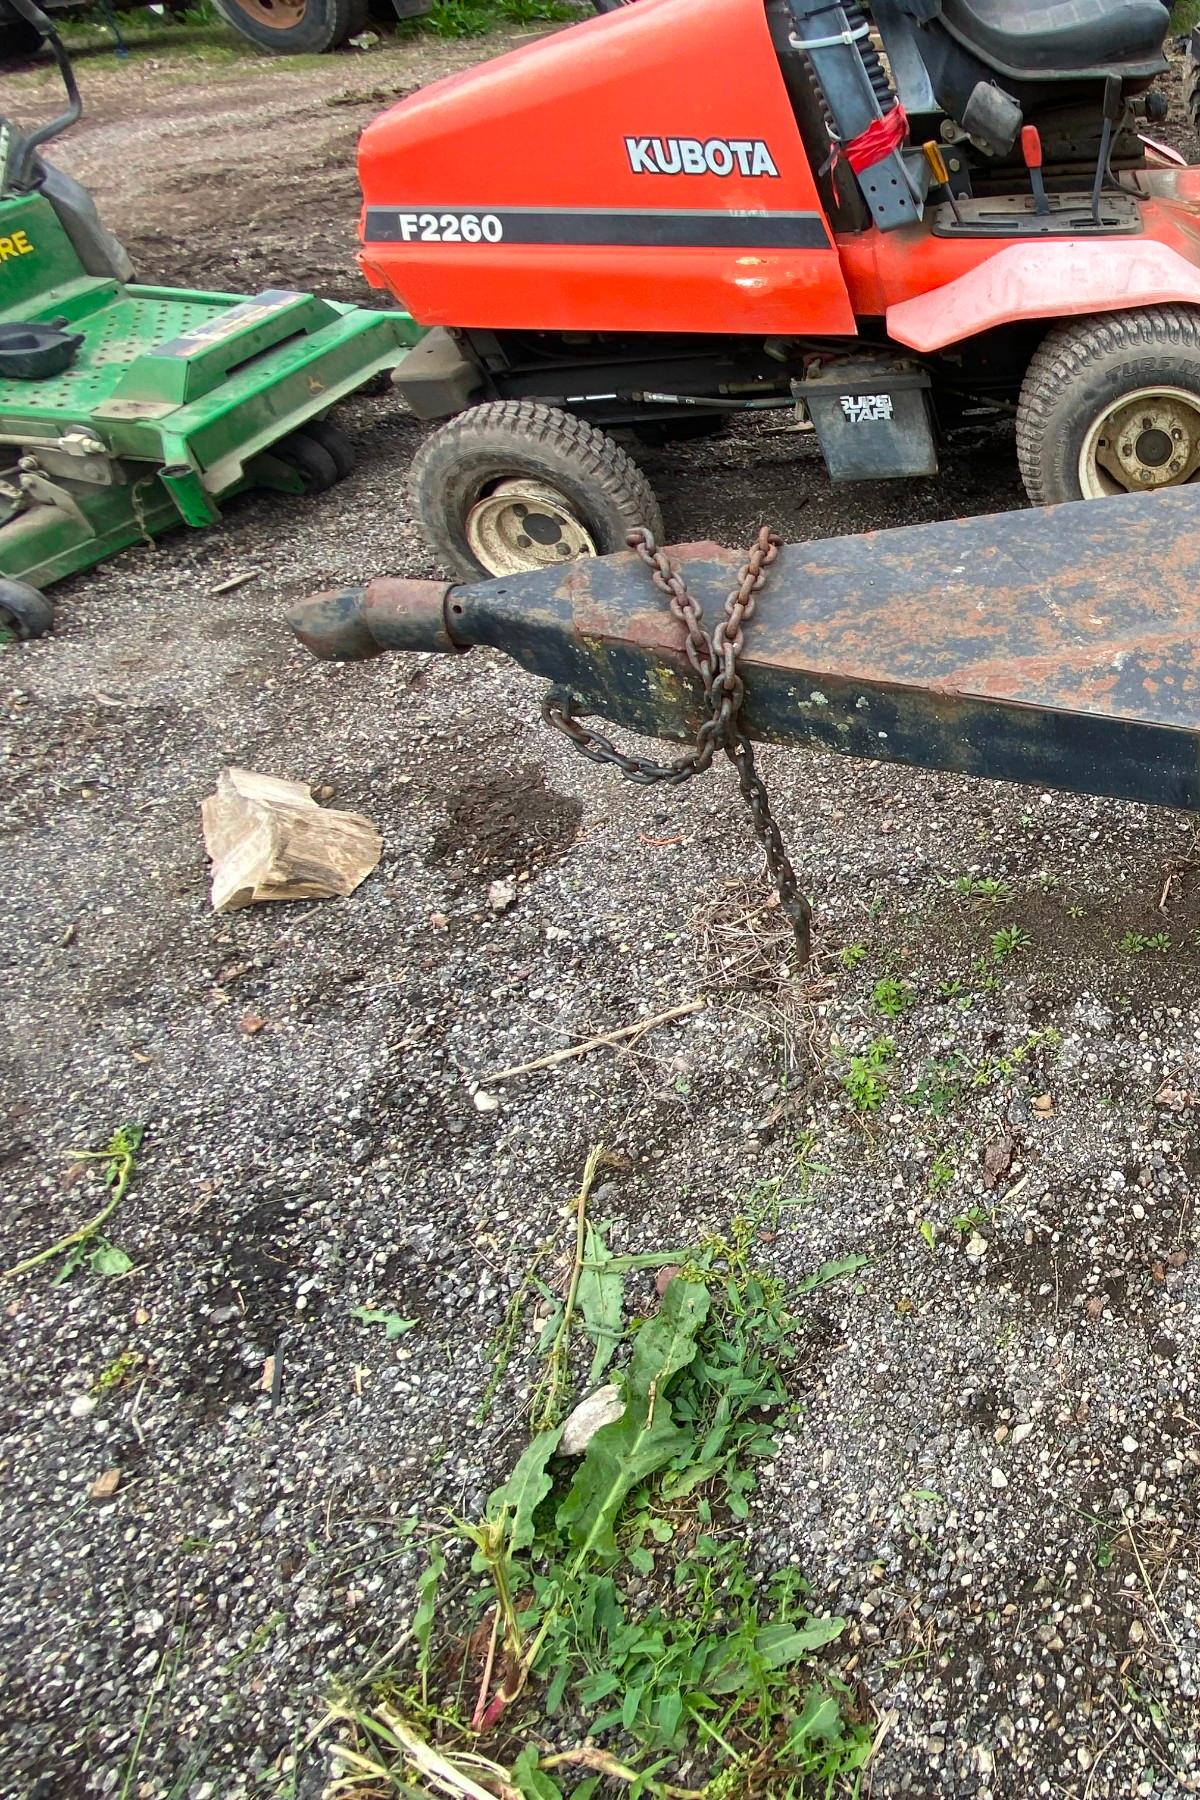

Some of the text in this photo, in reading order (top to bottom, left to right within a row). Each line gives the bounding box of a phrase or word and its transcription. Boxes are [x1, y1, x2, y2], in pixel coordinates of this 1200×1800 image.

[624, 136, 781, 178] KUBOTA
[398, 213, 504, 243] F2260
[0, 230, 35, 263] RE
[1104, 356, 1176, 381] TURF
